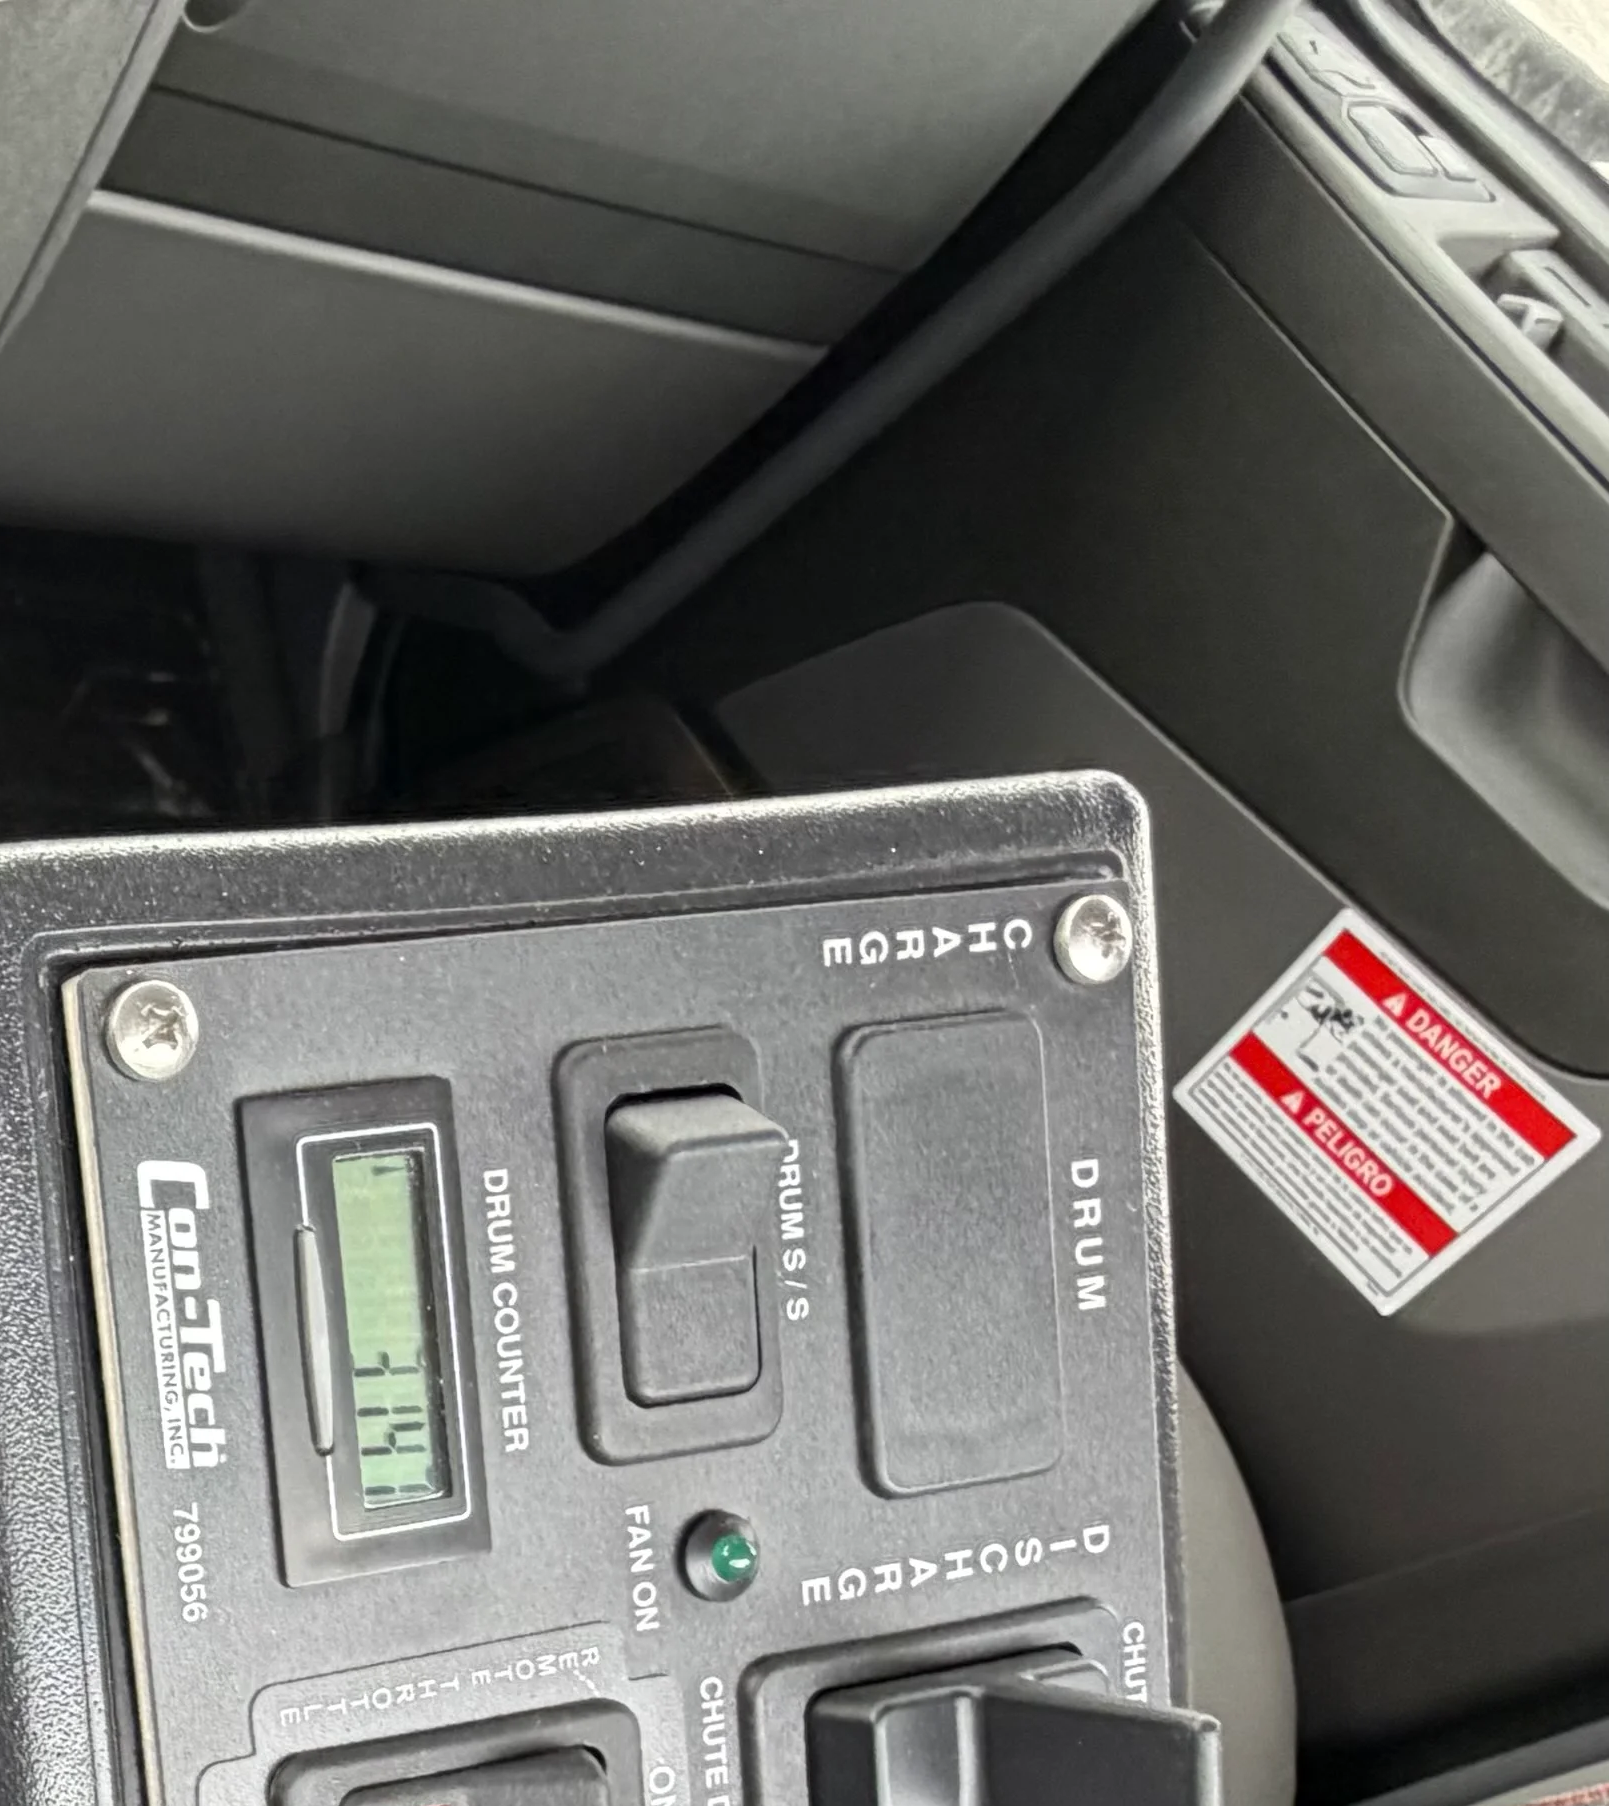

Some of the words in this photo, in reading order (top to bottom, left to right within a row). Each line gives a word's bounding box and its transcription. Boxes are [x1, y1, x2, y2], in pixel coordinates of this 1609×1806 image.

[822, 919, 1033, 967] CHARGE
[1406, 1009, 1502, 1099] DANGER
[1302, 1107, 1395, 1197] PELIGRO
[483, 1168, 518, 1276] DRUM
[1070, 1158, 1106, 1311] DRUM
[137, 1161, 227, 1467] Con-Tech
[145, 1213, 181, 1412] MANUFACTURING,
[168, 1417, 188, 1466] INC.
[492, 1281, 530, 1452] COUNTER
[173, 1503, 207, 1622] 799056
[625, 1504, 656, 1576] FAN
[801, 1525, 1110, 1606] DISCHARGE
[632, 1581, 660, 1632] ON
[283, 1680, 459, 1727] THROTTLE
[472, 1646, 600, 1686] REMOTE
[1122, 1621, 1148, 1703] CHUT
[699, 1676, 729, 1790] CHUTE
